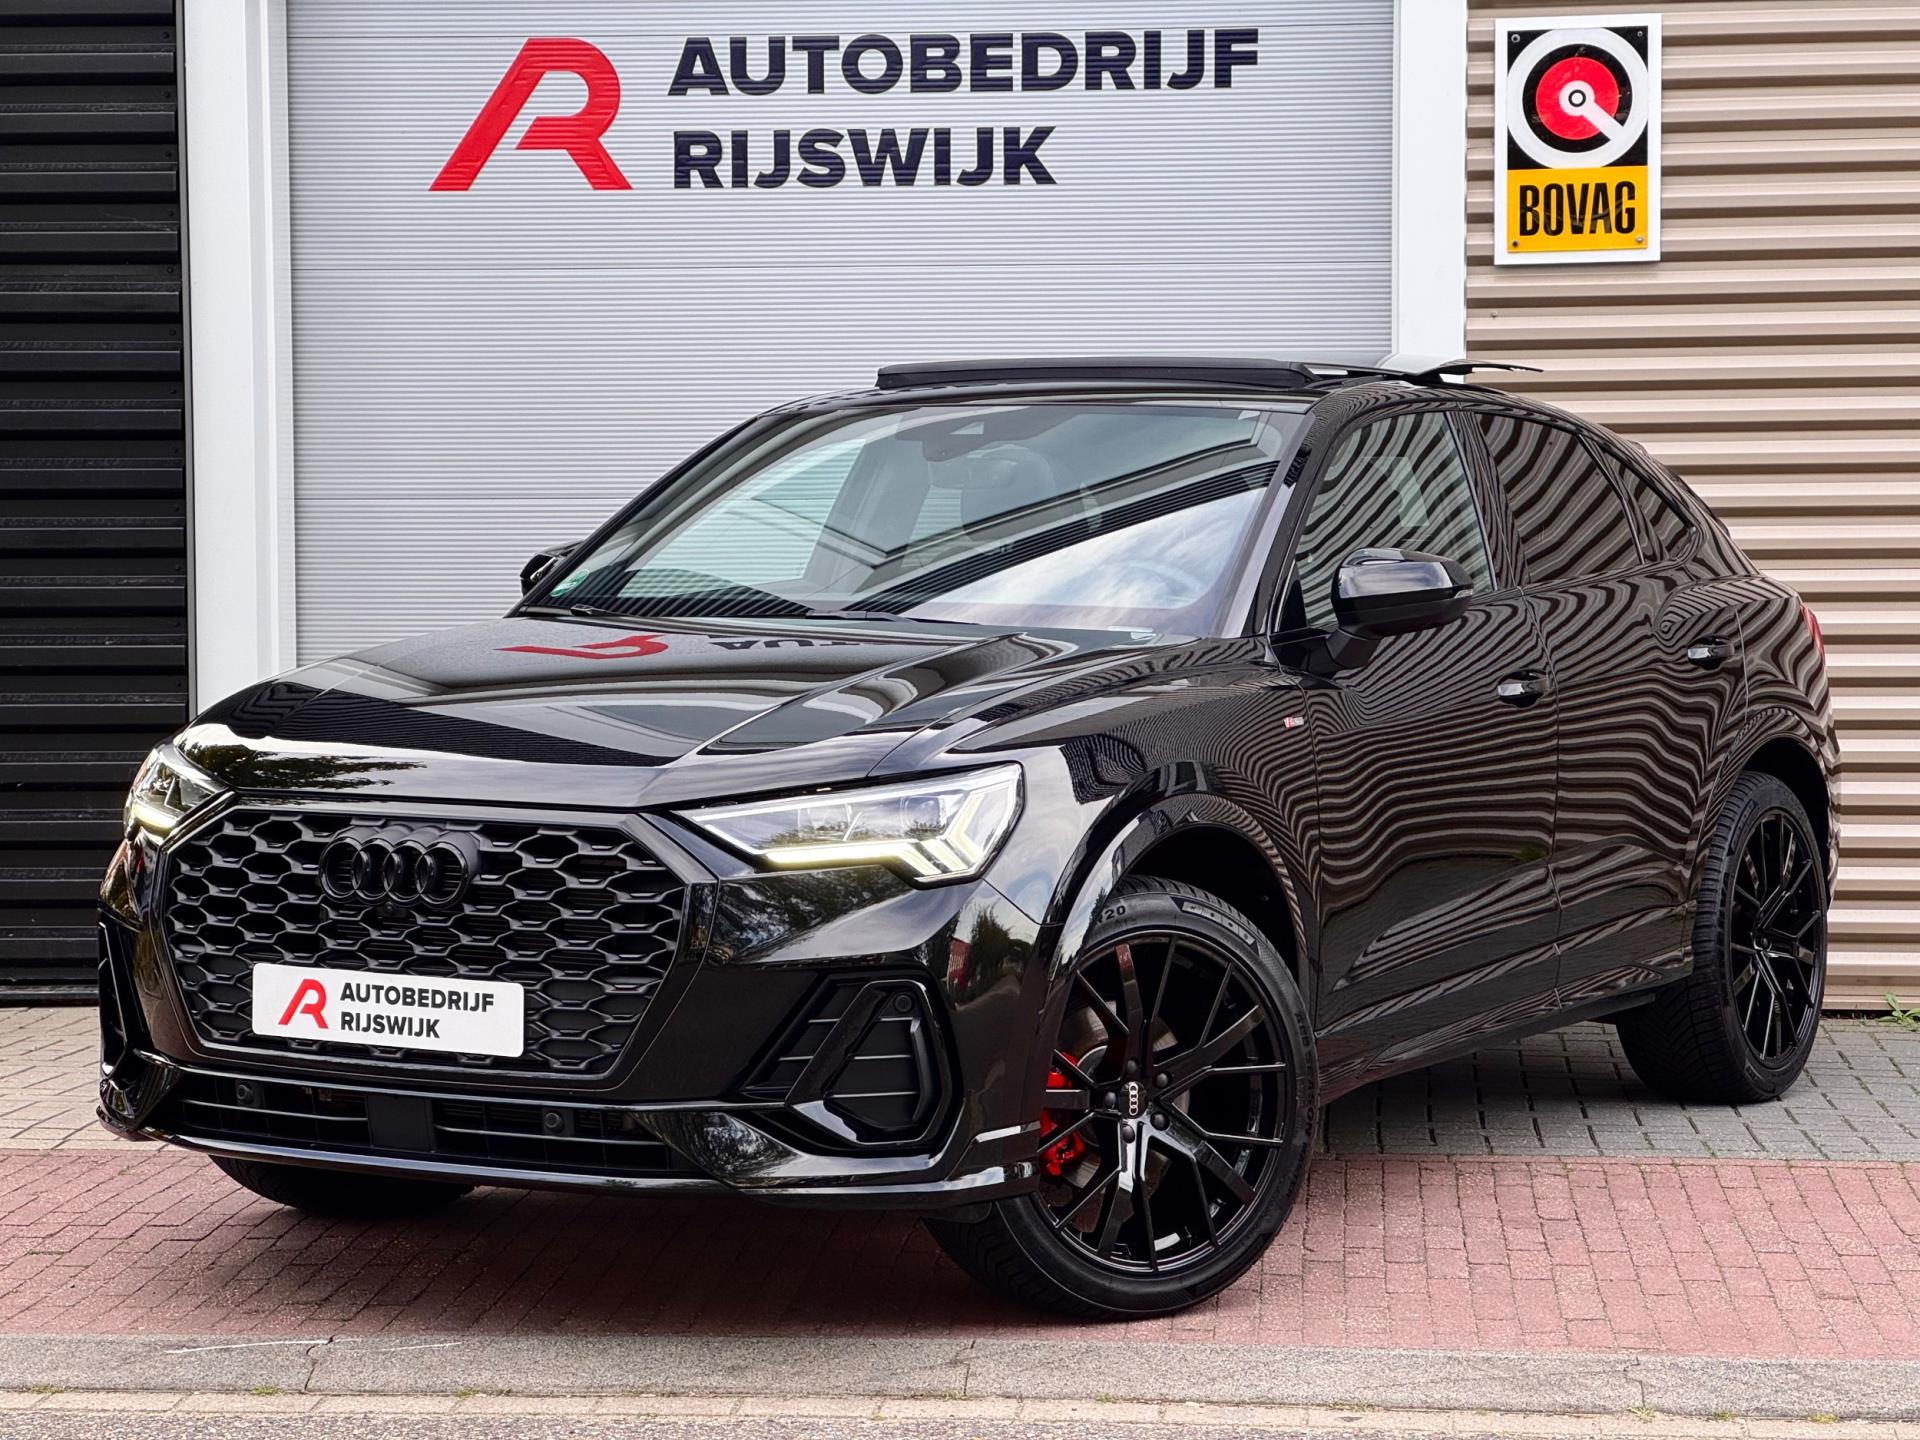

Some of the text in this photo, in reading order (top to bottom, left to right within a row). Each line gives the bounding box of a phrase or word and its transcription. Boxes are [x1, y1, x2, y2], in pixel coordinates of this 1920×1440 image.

[667, 28, 1259, 97] AUTOBEDRIJF
[673, 126, 1058, 189] RIJSWIJK
[1519, 180, 1636, 237] BOVAG
[340, 982, 495, 1012] AUTOBEDRIJF
[340, 1012, 440, 1038] RIJSWIJK
